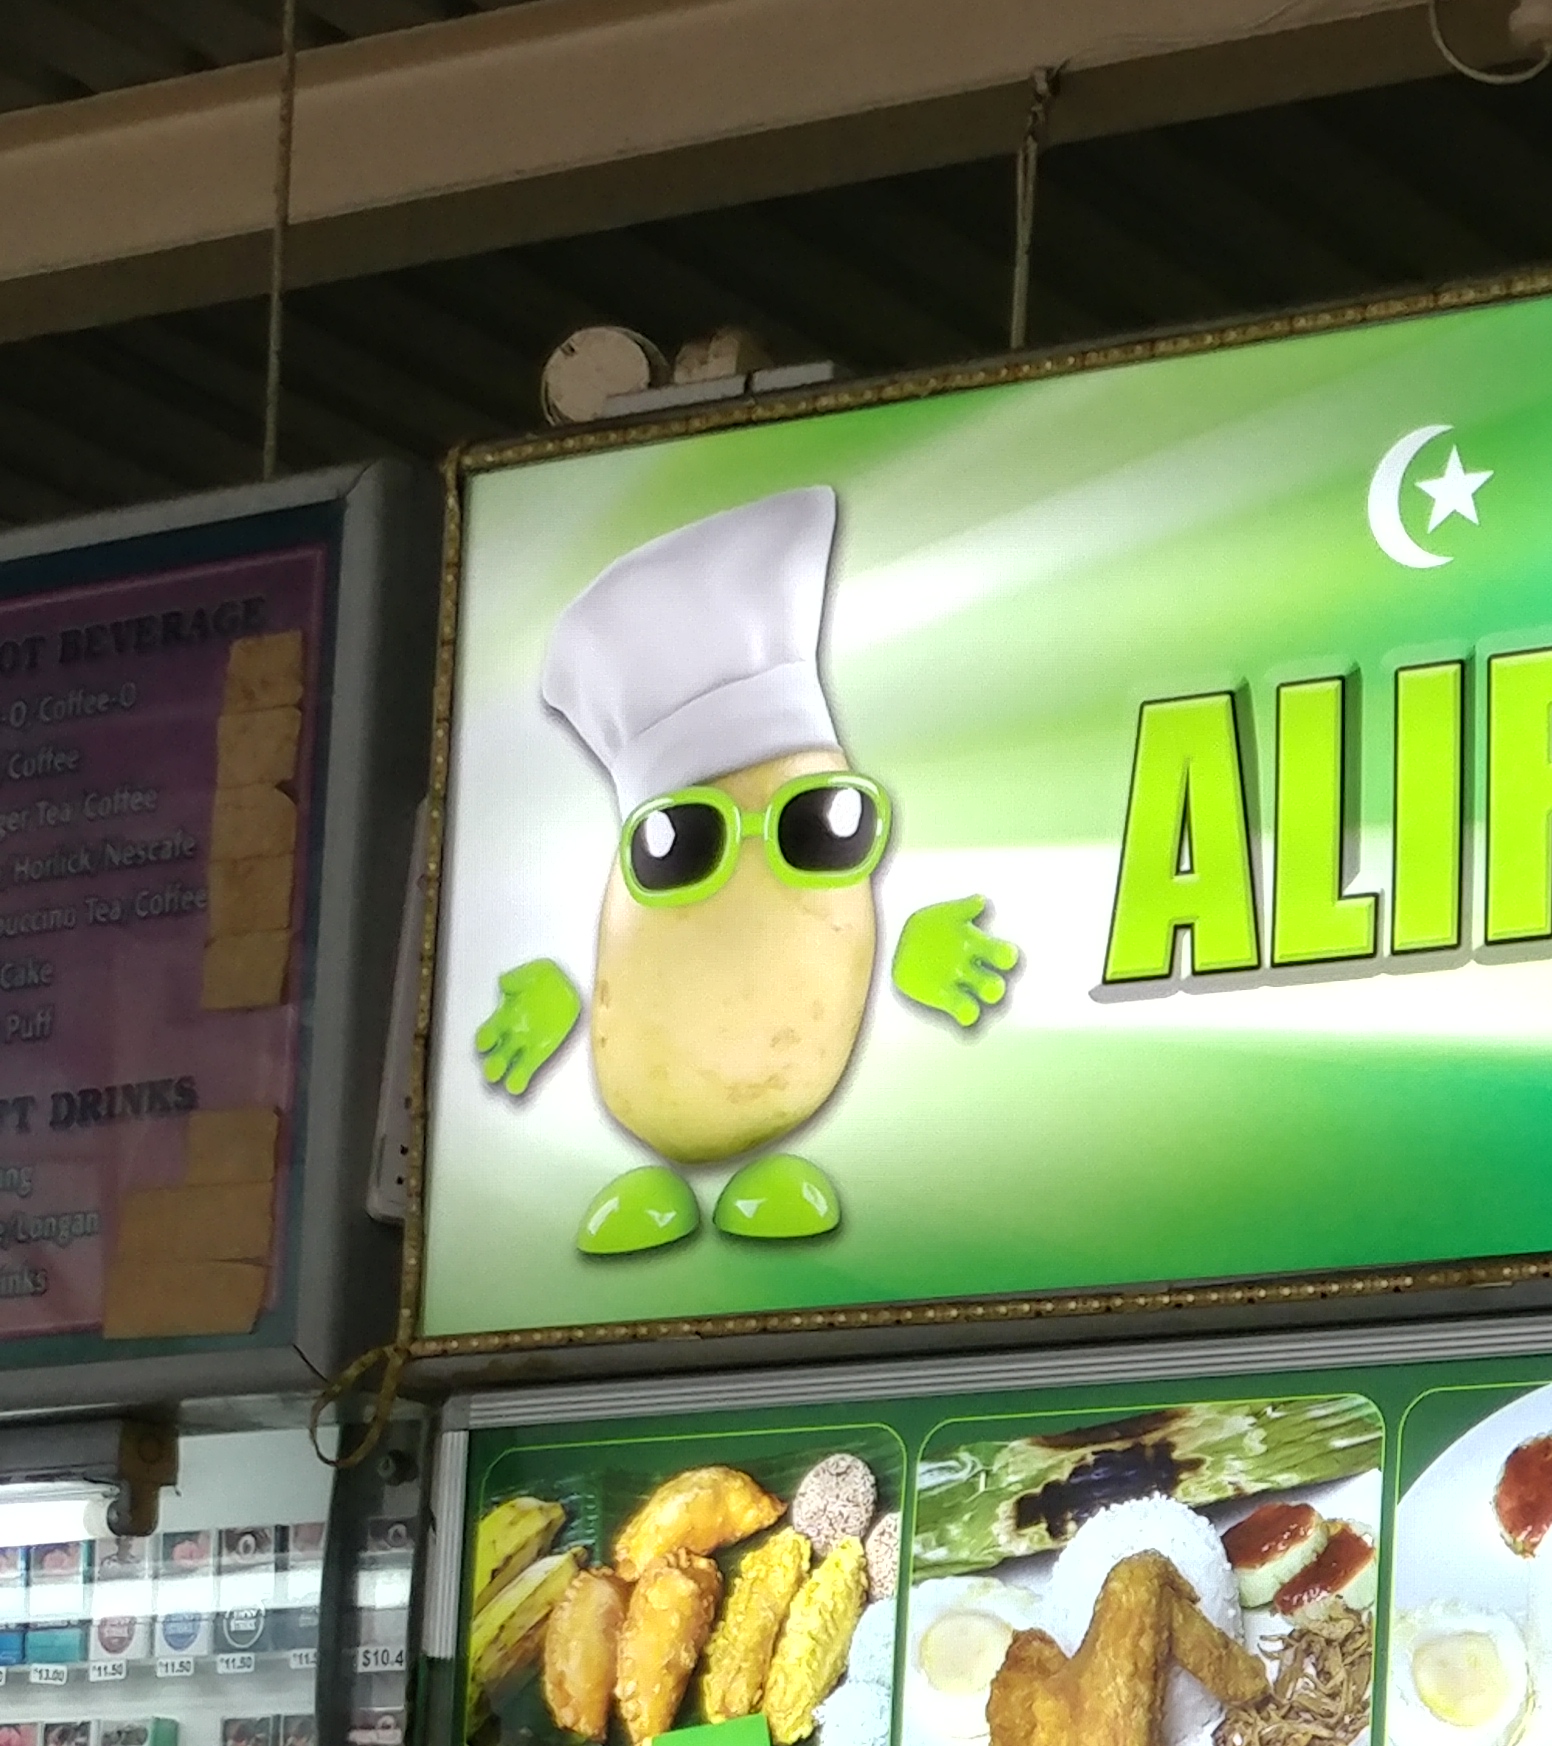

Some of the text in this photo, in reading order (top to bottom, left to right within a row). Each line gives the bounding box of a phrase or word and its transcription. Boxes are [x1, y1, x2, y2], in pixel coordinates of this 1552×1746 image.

[58, 596, 266, 664] BEVERAGE
[84, 785, 158, 820] Coffee
[135, 883, 208, 918] Coffee
[0, 958, 51, 987] Cake
[5, 1005, 51, 1041] Puff
[49, 1075, 198, 1131] DRINKS
